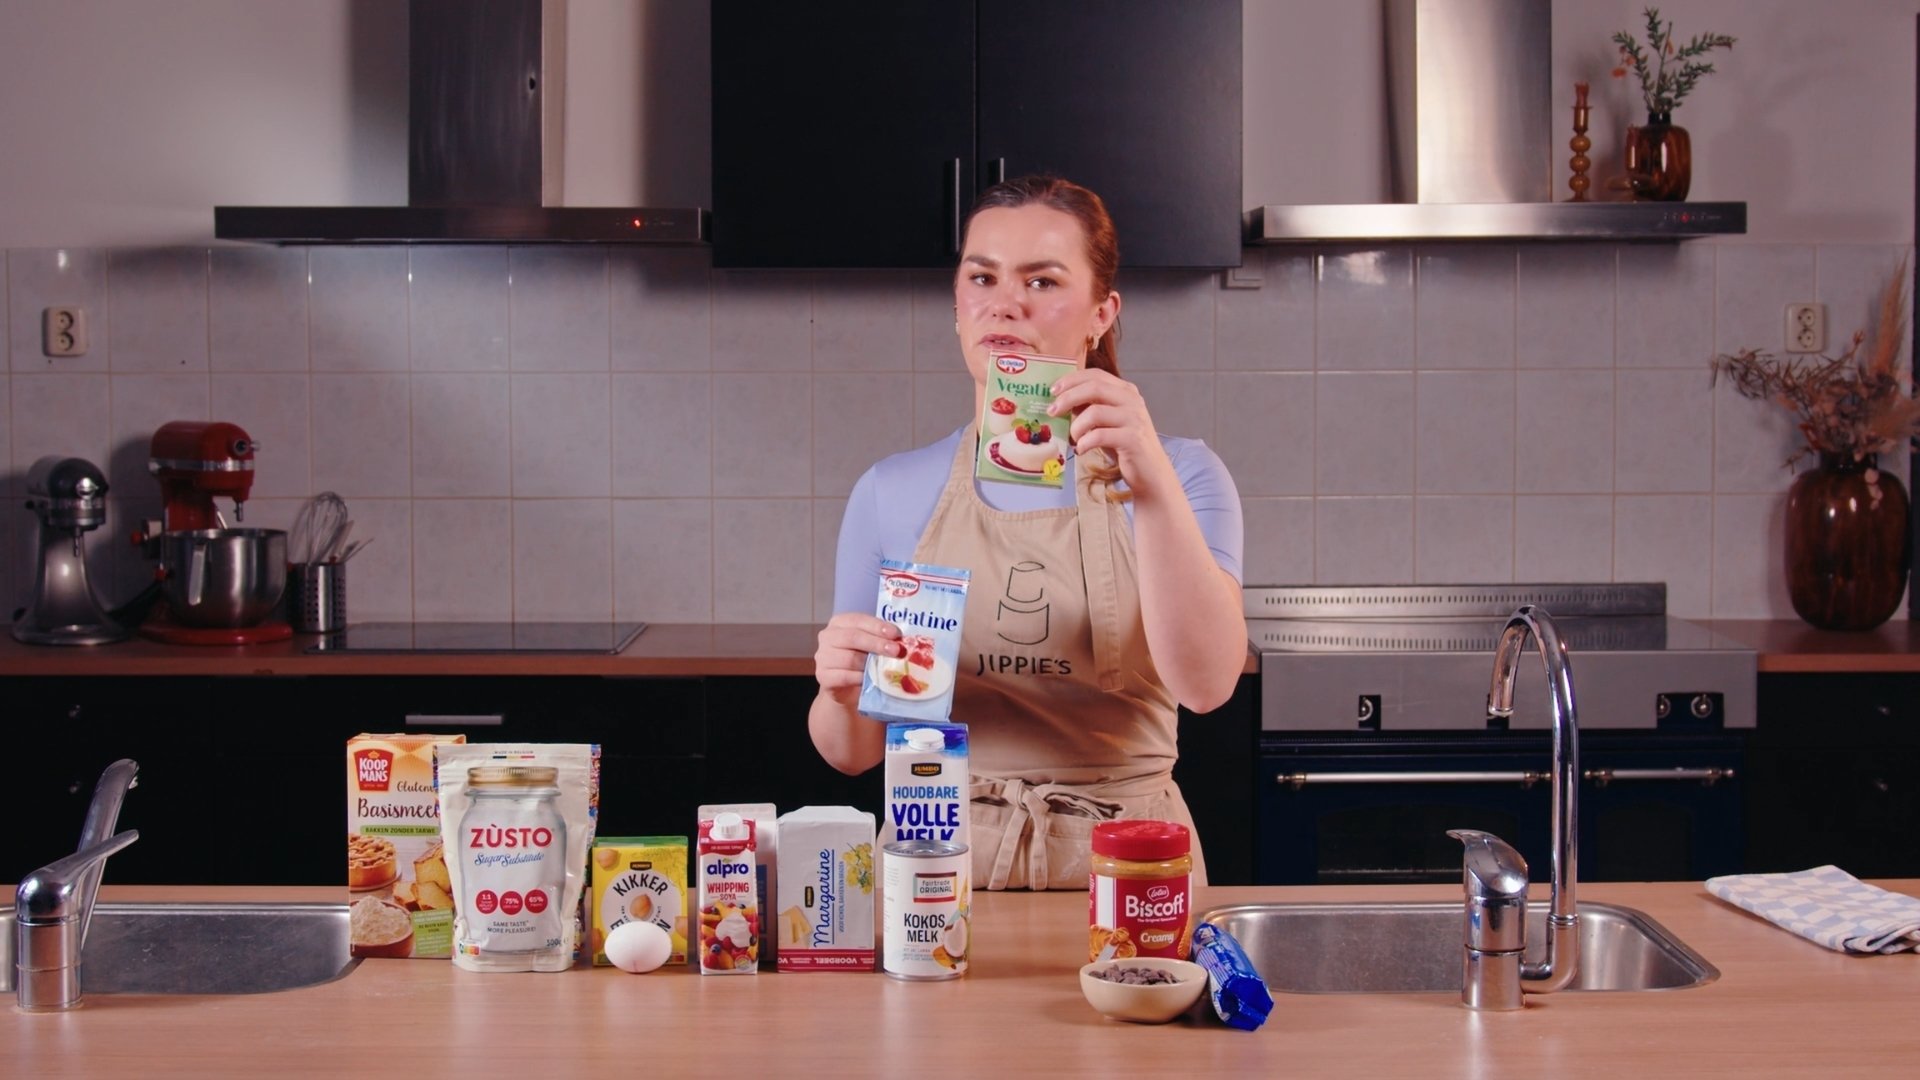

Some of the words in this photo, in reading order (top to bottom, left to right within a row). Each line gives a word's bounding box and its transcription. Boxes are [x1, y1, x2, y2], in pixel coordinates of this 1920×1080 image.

[881, 604, 958, 632] Gelatine
[977, 654, 1072, 677] JIPPIE'S
[359, 758, 388, 771] KOOP
[359, 770, 388, 782] MANS
[893, 786, 959, 799] HOUDBARE
[891, 803, 960, 827] VOLLE
[470, 823, 552, 848] ZÙSTO
[707, 859, 749, 878] alpro
[613, 873, 669, 897] KIKKER
[707, 882, 750, 894] WHIPPING
[920, 886, 952, 894] ORIGINAL
[719, 893, 737, 901] SOYA
[813, 849, 836, 948] Margarine
[1125, 891, 1184, 918] Biscoff
[904, 912, 945, 929] KOKOS
[907, 929, 939, 943] MELK
[1140, 932, 1175, 944] Creamy
